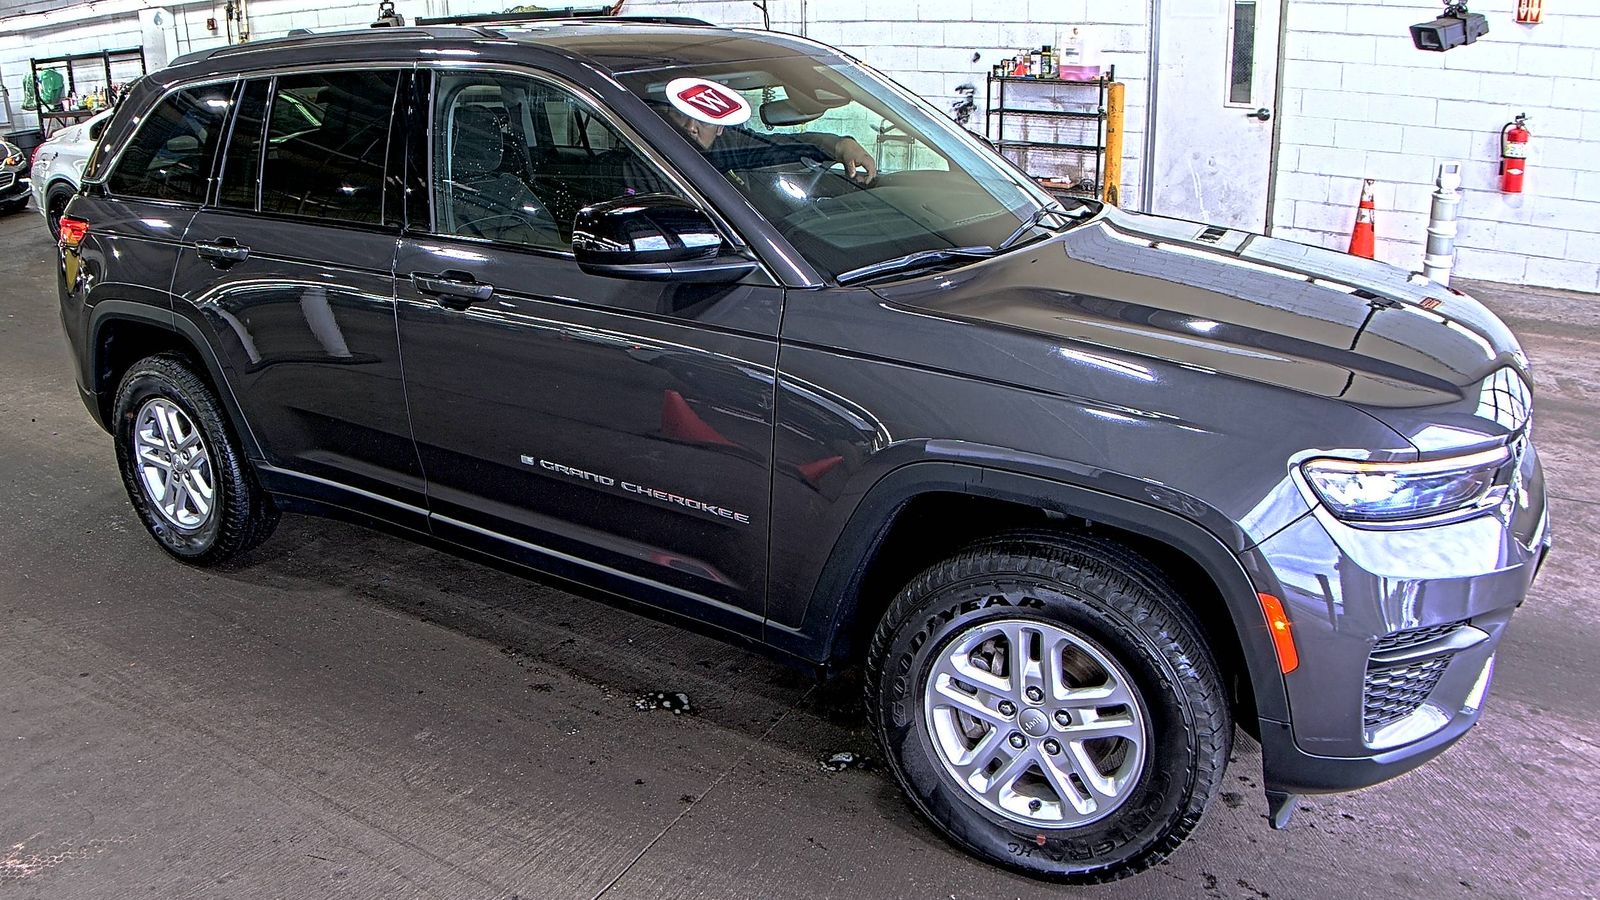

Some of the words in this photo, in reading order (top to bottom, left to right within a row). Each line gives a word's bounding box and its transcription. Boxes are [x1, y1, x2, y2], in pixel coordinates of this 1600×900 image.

[687, 88, 730, 113] W
[540, 459, 615, 486] GRAND
[620, 481, 750, 525] CHEROKEE
[892, 594, 1046, 727] GOODYEAR
